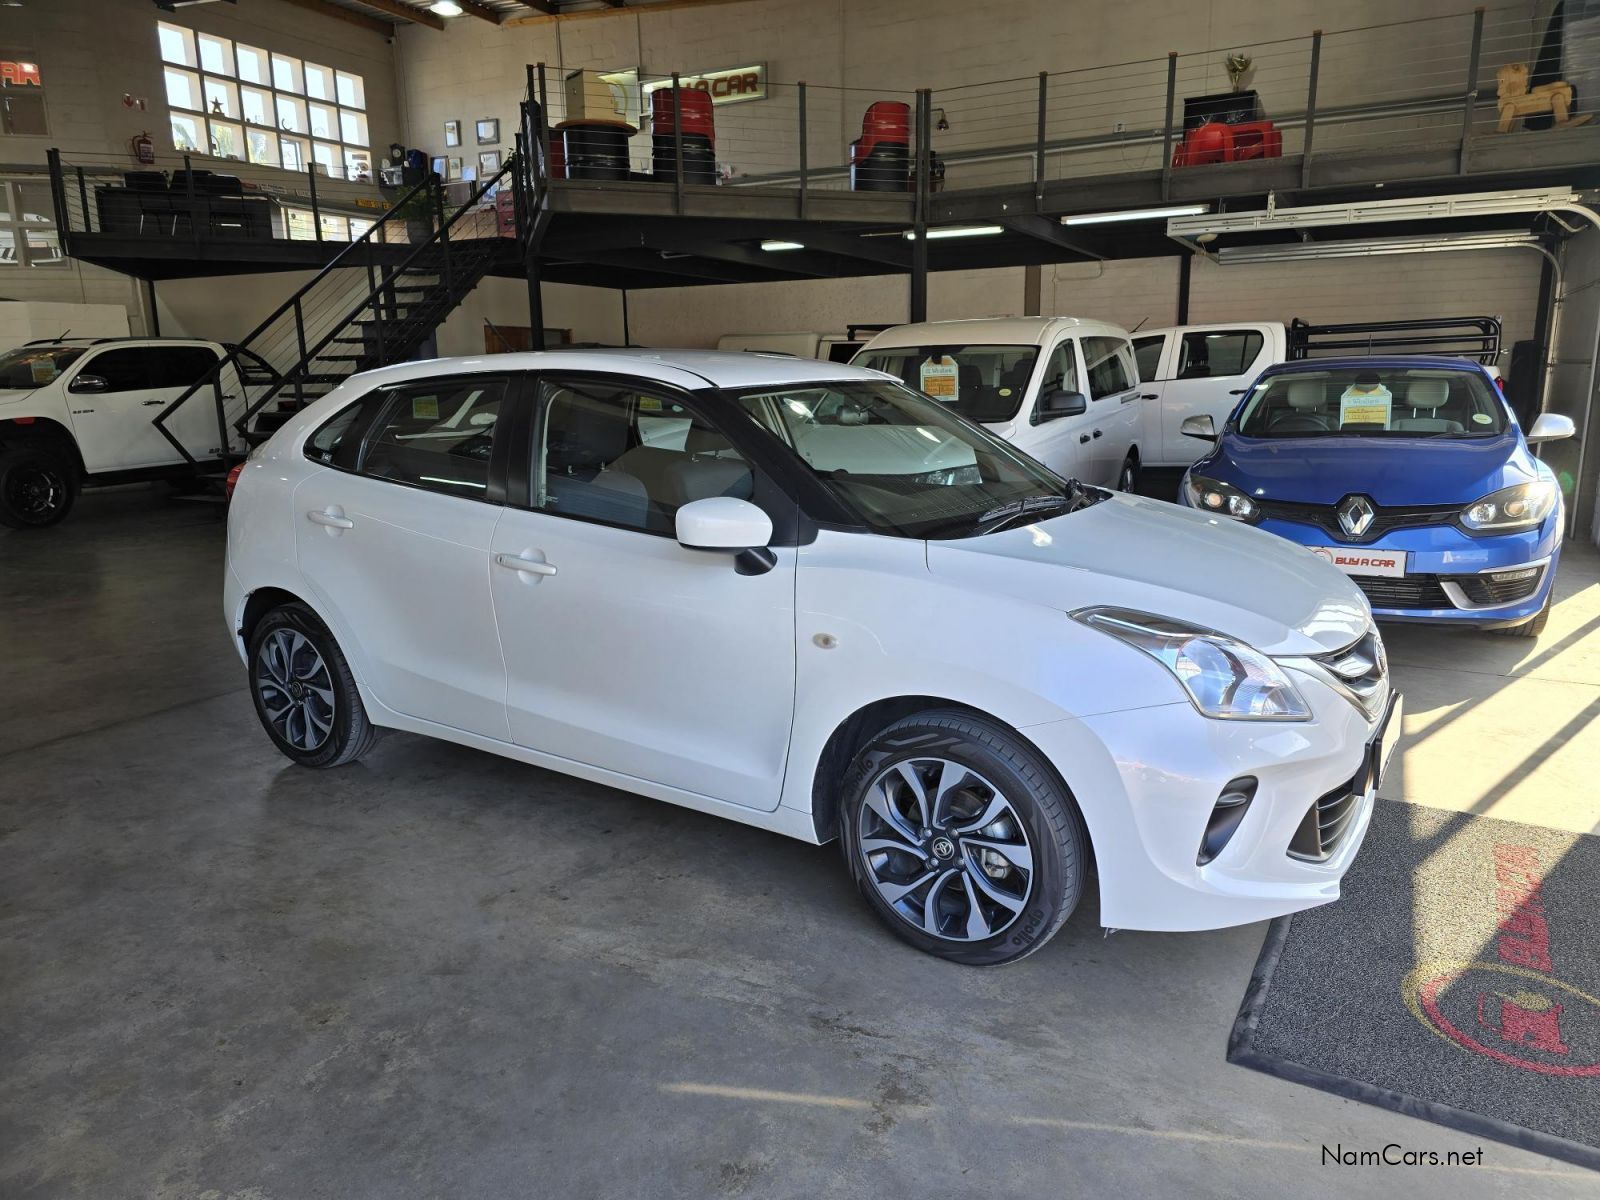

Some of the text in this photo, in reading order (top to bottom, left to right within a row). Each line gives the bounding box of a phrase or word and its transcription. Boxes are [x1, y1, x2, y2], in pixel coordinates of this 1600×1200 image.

[712, 73, 758, 97] CAR
[1335, 556, 1396, 568] BUY A CAR
